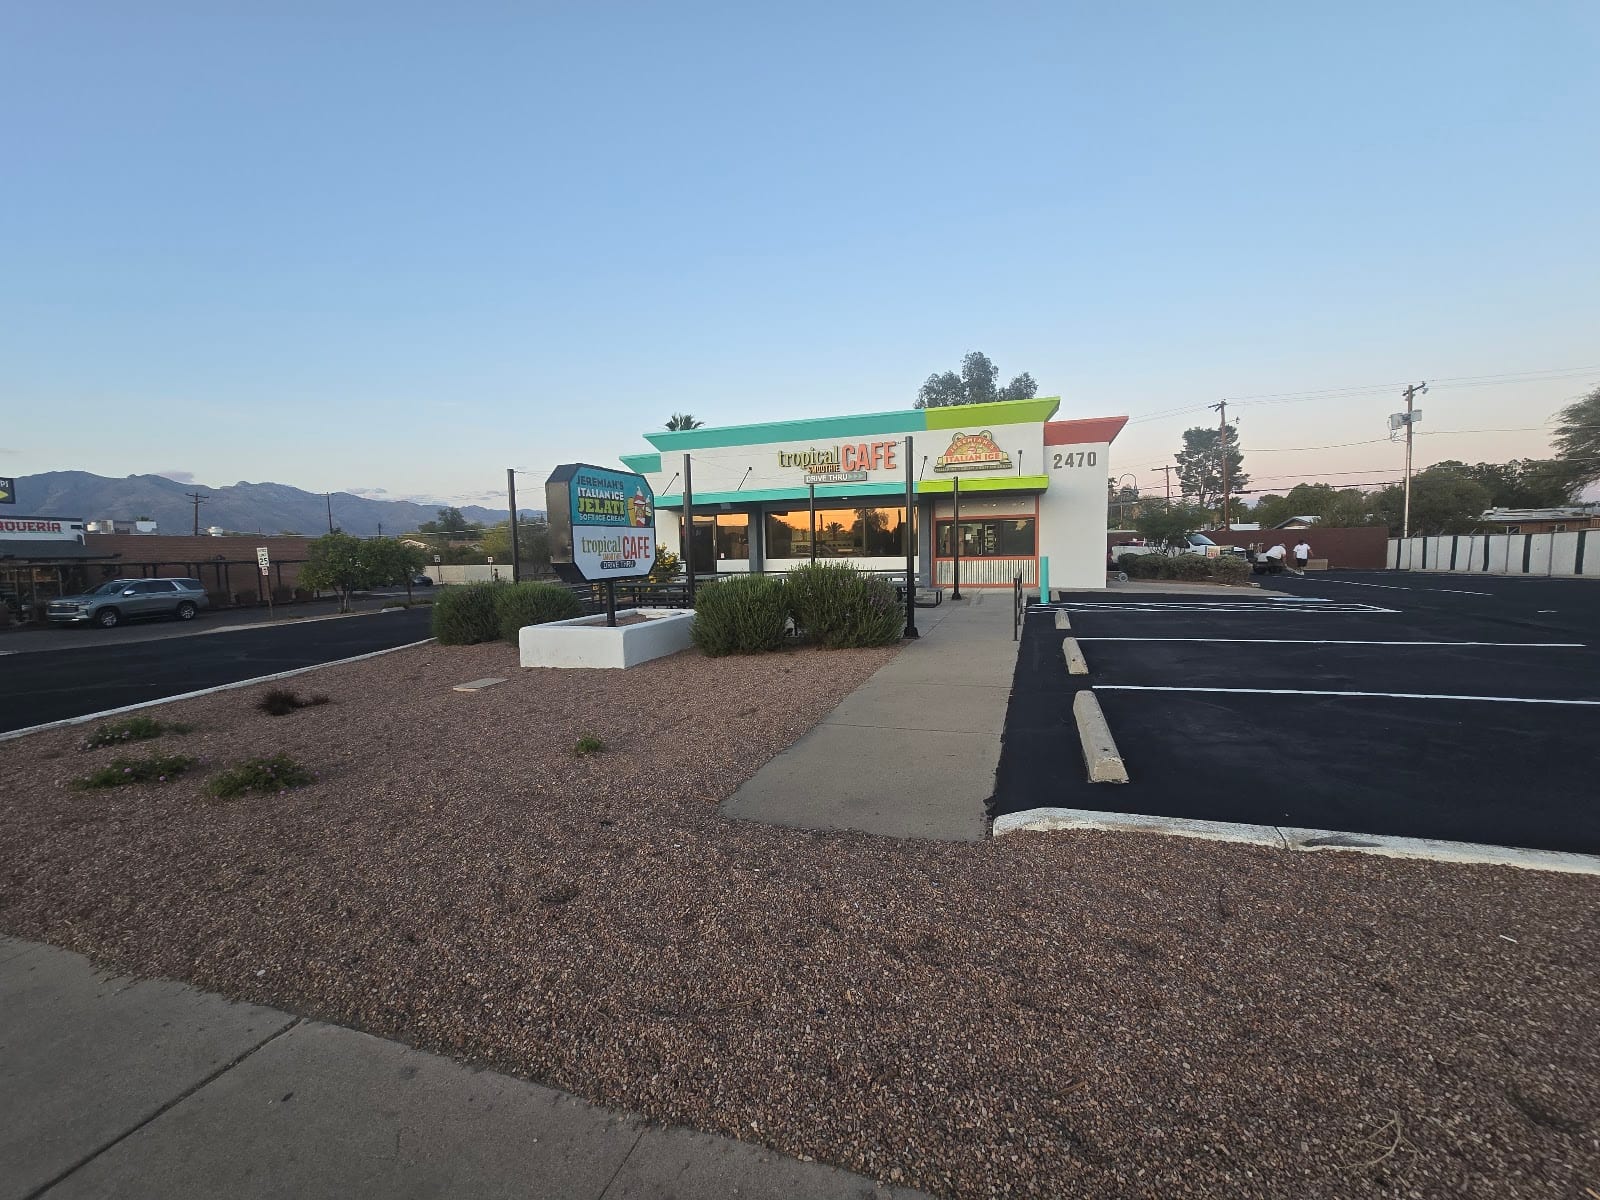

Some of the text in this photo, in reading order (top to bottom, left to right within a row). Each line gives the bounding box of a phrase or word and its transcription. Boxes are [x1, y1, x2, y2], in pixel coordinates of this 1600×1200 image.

[778, 441, 897, 472] tropical CAFE
[945, 452, 1001, 464] ITALIAN ICE
[1053, 451, 1097, 470] 2470
[576, 475, 624, 490] JEREMIAH'S
[806, 473, 849, 483] DRIVE THRU
[578, 487, 625, 500] ITALIAN ICE
[578, 497, 625, 515] JELATI
[579, 513, 596, 521] SOFT
[606, 514, 626, 522] CREAM
[582, 535, 651, 559] tropical CAFE
